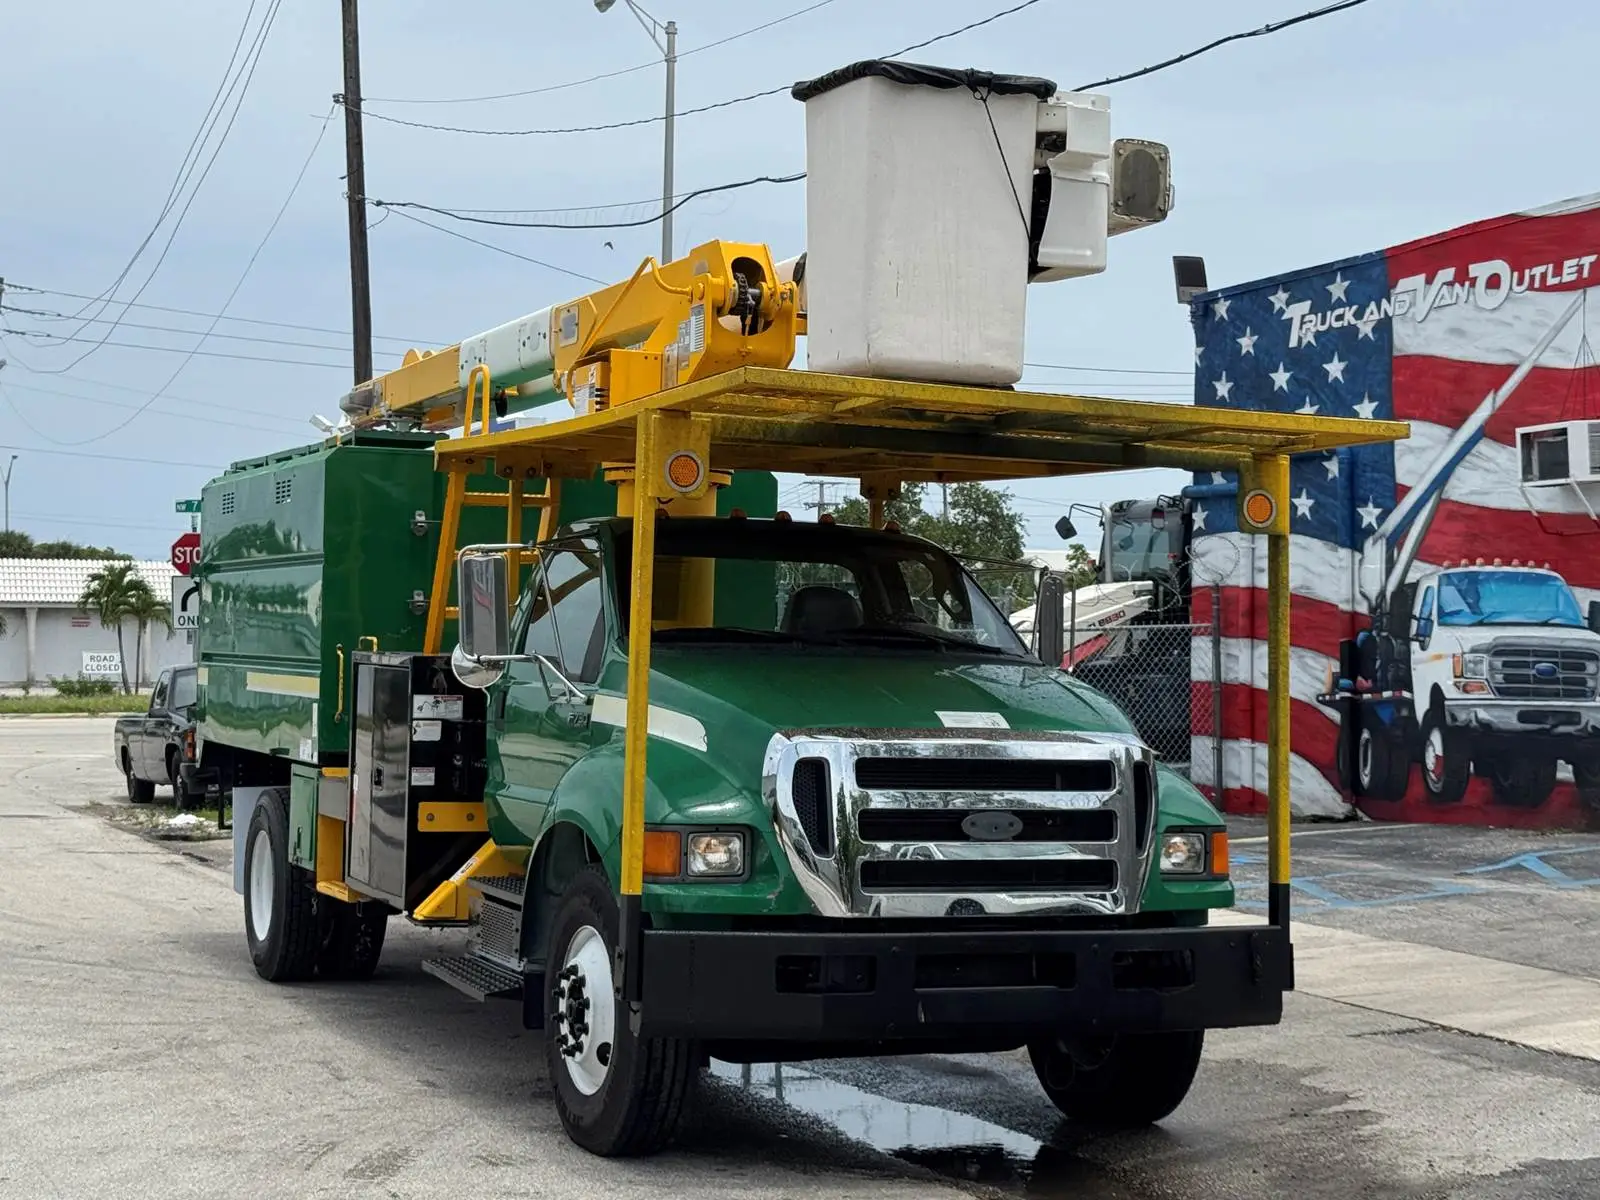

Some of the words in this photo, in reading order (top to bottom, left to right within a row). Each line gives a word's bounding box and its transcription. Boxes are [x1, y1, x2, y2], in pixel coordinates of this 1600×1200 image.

[1281, 300, 1359, 348] TRUCK
[1363, 296, 1411, 322] AND
[1394, 267, 1470, 323] VAN
[1468, 254, 1598, 310] OUTLET
[174, 546, 201, 564] STO
[177, 615, 200, 627] ON
[89, 654, 116, 663] ROAD
[84, 663, 120, 672] CLOSED
